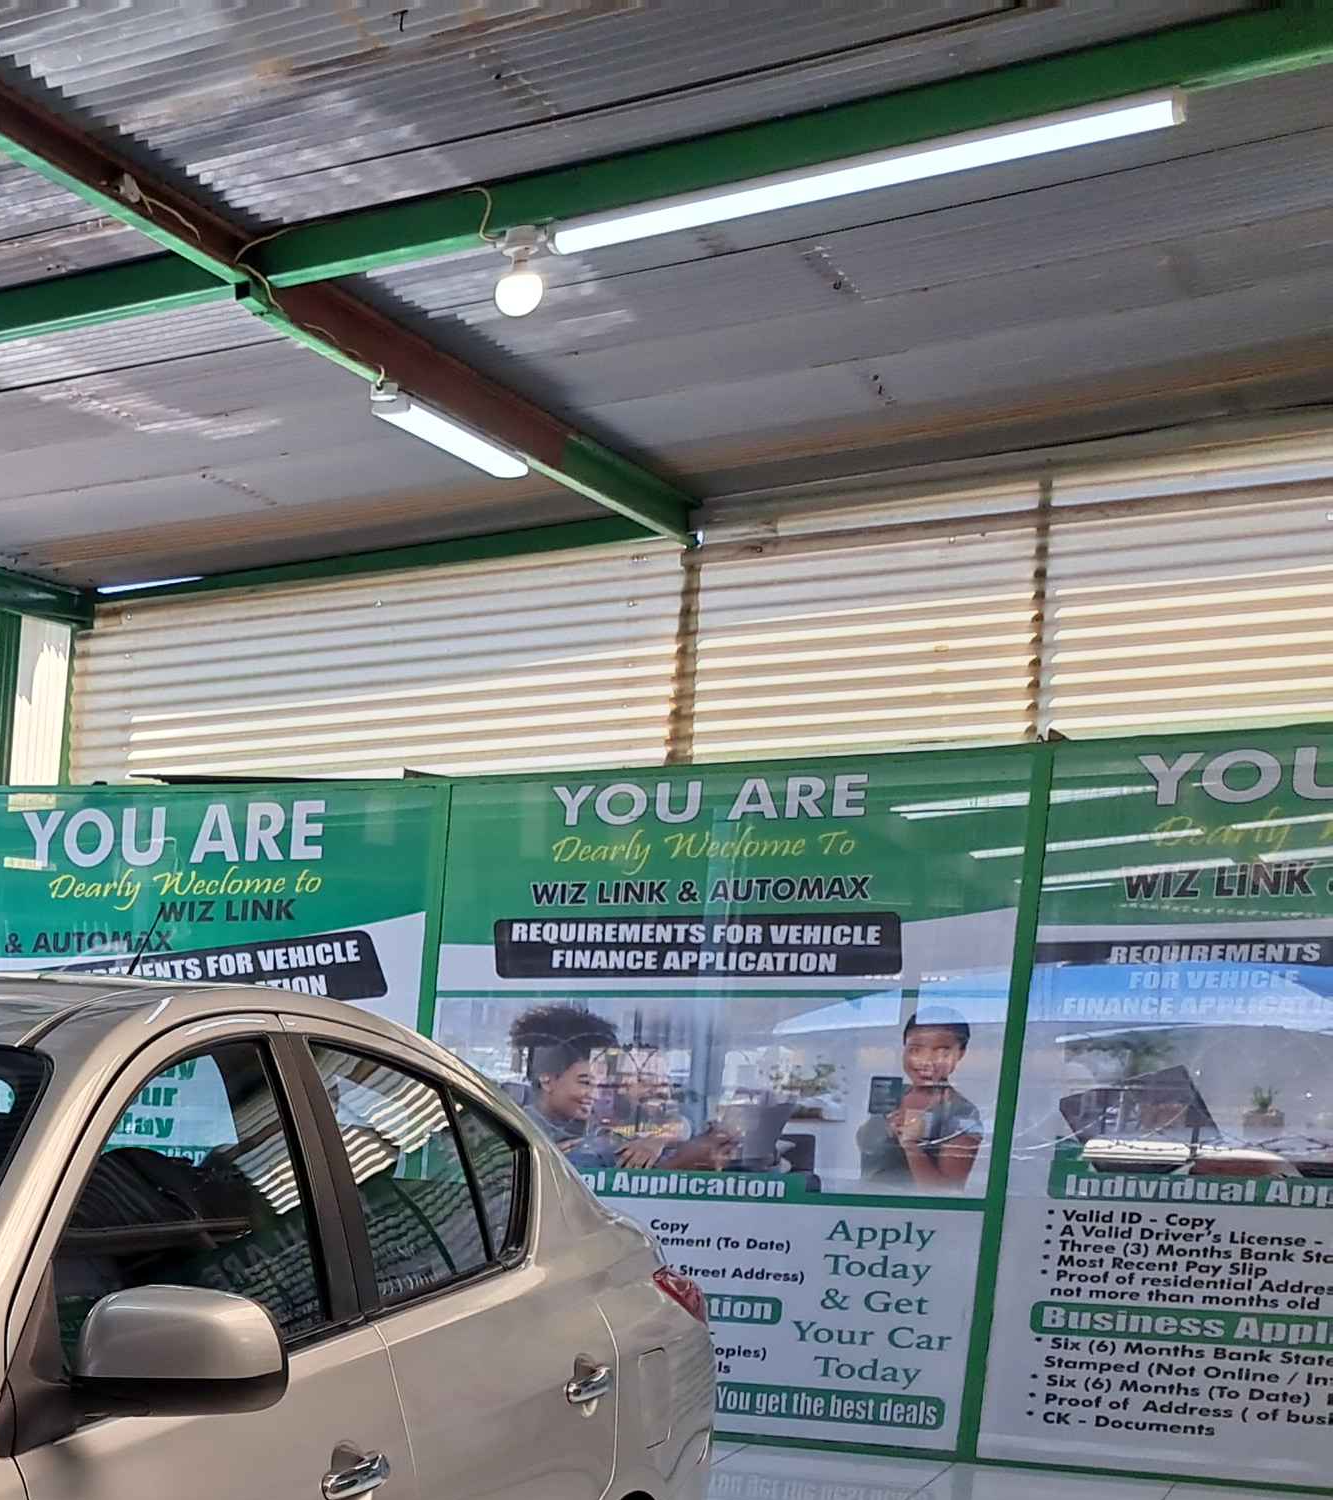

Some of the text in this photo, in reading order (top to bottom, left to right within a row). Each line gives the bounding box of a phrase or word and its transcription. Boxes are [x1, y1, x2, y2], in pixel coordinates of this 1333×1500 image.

[1138, 746, 1333, 805] YOU
[552, 774, 869, 826] YOU ARE
[22, 800, 327, 868] YOU ARE
[552, 829, 652, 875] Dearly
[819, 830, 855, 856] To
[48, 867, 141, 911] Dearly
[293, 868, 322, 894] to
[532, 875, 871, 907] WIZ LINK & AUTOMAX
[1124, 861, 1317, 901] WIZ LINK
[159, 898, 298, 923] WIZ LINK
[4, 930, 172, 953] & AUTOMAX
[511, 922, 881, 946] REQUIREMENTS FOR VEHICLE
[207, 951, 254, 976] FOR
[259, 940, 361, 971] VEHICLE
[551, 950, 837, 973] FINANCE APPLICATION
[1109, 942, 1321, 965] REQUIREMENTS
[1129, 969, 1300, 990] FOR VEHICLE
[1062, 997, 1173, 1016] FINANCE
[612, 1172, 785, 1199] Application
[1065, 1174, 1256, 1202] Individual
[650, 1219, 689, 1234] Copy
[1062, 1209, 1114, 1223] Valid
[1121, 1212, 1142, 1224] ID
[1166, 1213, 1216, 1230] Copy
[716, 1236, 740, 1250] (To
[746, 1238, 790, 1254] Date)
[825, 1219, 936, 1251] Apply
[1060, 1224, 1074, 1237] A
[1082, 1225, 1132, 1239] Valid
[1230, 1231, 1306, 1247] License
[1059, 1240, 1116, 1254] Three
[1123, 1242, 1149, 1257] (3)
[1157, 1244, 1232, 1259] Months
[1240, 1247, 1294, 1262] Bank
[679, 1264, 805, 1285] Street Address)
[824, 1254, 931, 1286] Today
[1056, 1270, 1109, 1283] Proof
[1115, 1272, 1136, 1285] of
[1141, 1274, 1252, 1291] residential
[1057, 1255, 1268, 1279] Most Recent Pay Slip
[820, 1288, 929, 1315] & Get
[1050, 1286, 1320, 1310] not more than months old
[792, 1320, 952, 1351] Your Car
[1042, 1306, 1225, 1338] Business
[1050, 1337, 1081, 1351] Six
[1088, 1339, 1116, 1355] (6)
[1124, 1342, 1205, 1359] Months
[1214, 1347, 1272, 1363] Bank
[814, 1355, 922, 1390] Today
[1044, 1355, 1140, 1374] Stamped
[1148, 1362, 1196, 1378] (Not
[1204, 1366, 1280, 1383] Online
[1046, 1374, 1077, 1388] Six
[1084, 1376, 1112, 1393] (6)
[1120, 1379, 1200, 1397] Months
[1208, 1385, 1240, 1401] (To
[1249, 1388, 1310, 1407] Date)
[716, 1385, 938, 1426] You get the best deals
[1045, 1393, 1102, 1408] Proof
[1108, 1398, 1130, 1410] of
[1142, 1400, 1233, 1418] Address
[1257, 1408, 1279, 1421] of
[1043, 1411, 1071, 1425] CK
[1094, 1415, 1216, 1436] Documents
